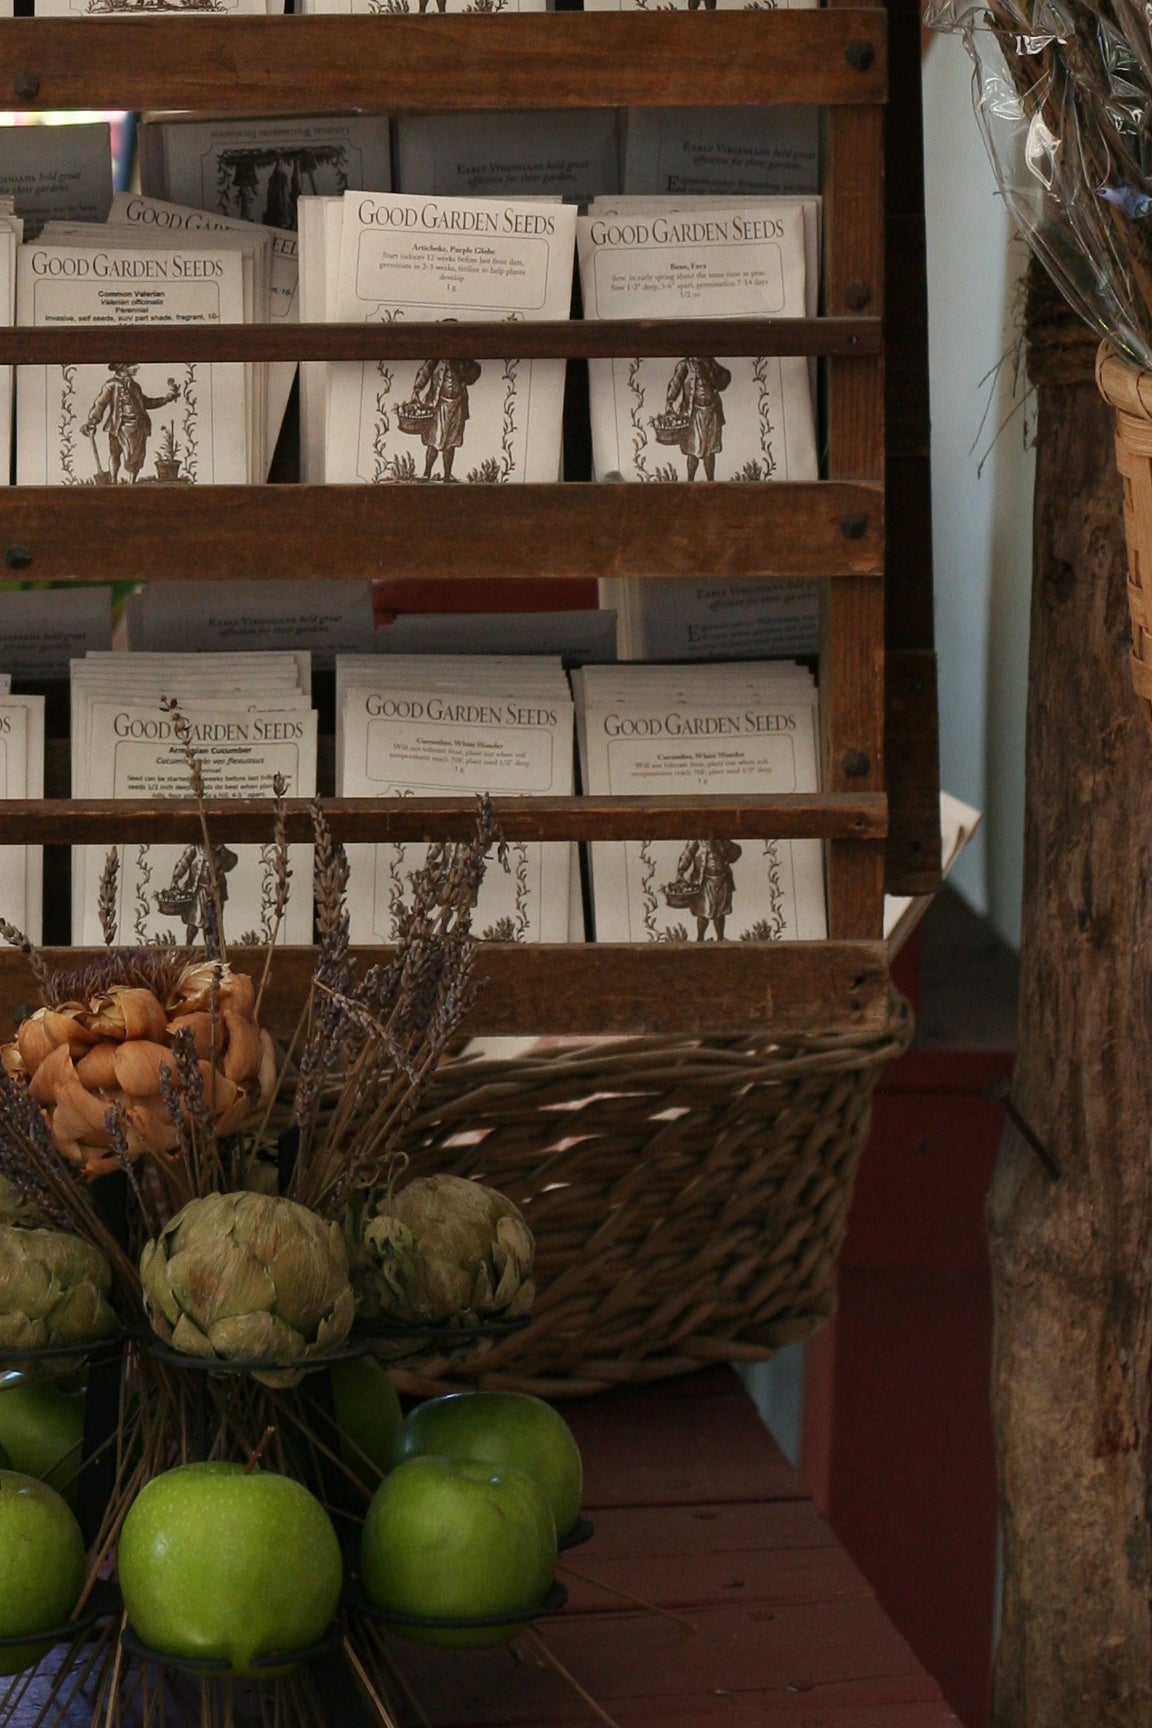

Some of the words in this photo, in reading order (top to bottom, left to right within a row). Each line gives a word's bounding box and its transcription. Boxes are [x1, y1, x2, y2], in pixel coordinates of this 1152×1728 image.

[358, 200, 418, 226] GOOD
[421, 204, 498, 232] GARDEN
[503, 208, 556, 234] SEEDS
[590, 222, 648, 246] GOOD
[652, 219, 728, 243] GARDEN
[732, 216, 784, 240] SEEDS
[32, 252, 88, 276] GOOD
[93, 254, 168, 278] GARDEN
[172, 255, 223, 276] SEEDS
[366, 694, 423, 718] GOOD
[427, 699, 501, 722] GARDEN
[506, 704, 557, 726] SEEDS
[604, 714, 661, 736] GOOD
[666, 714, 740, 735] GARDEN
[745, 711, 796, 732] SEEDS
[114, 713, 170, 738] GOOD
[252, 718, 304, 740] SEEDS
